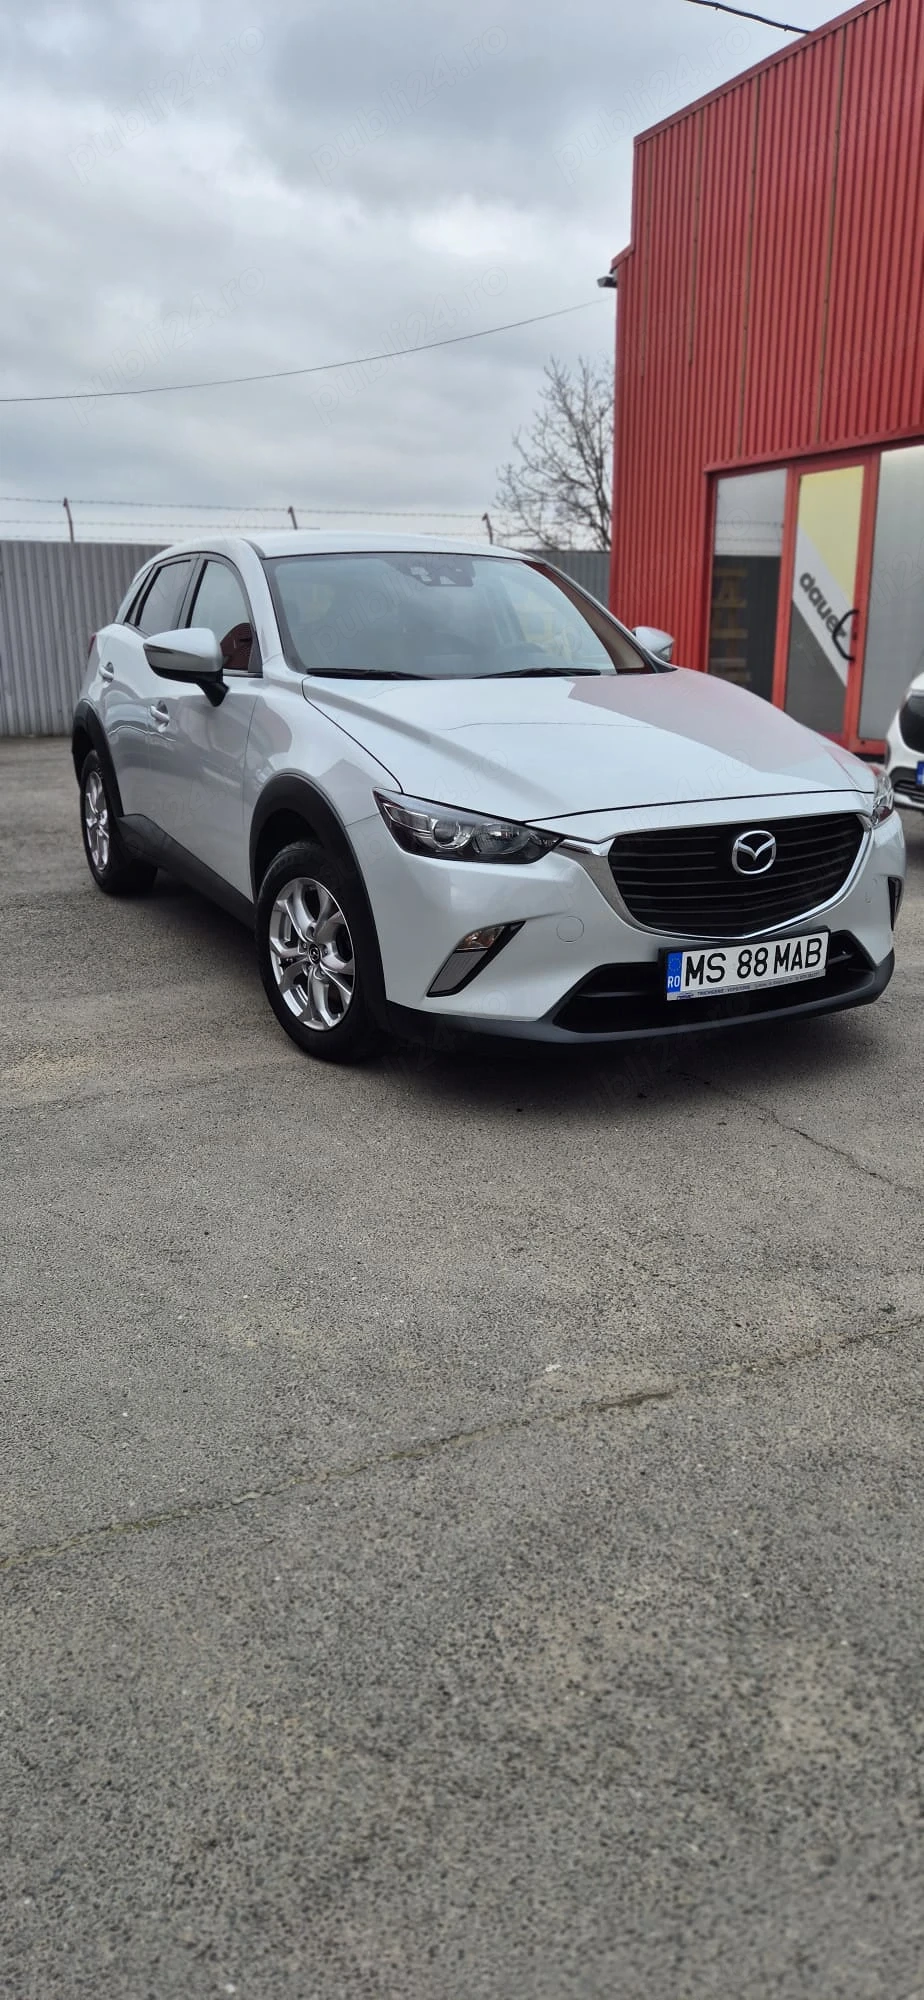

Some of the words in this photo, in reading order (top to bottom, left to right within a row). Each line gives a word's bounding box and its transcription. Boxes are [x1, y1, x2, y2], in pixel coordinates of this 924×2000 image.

[685, 952, 726, 987] MS
[737, 947, 769, 979] 88
[774, 937, 822, 975] MAB
[668, 975, 681, 989] RO
